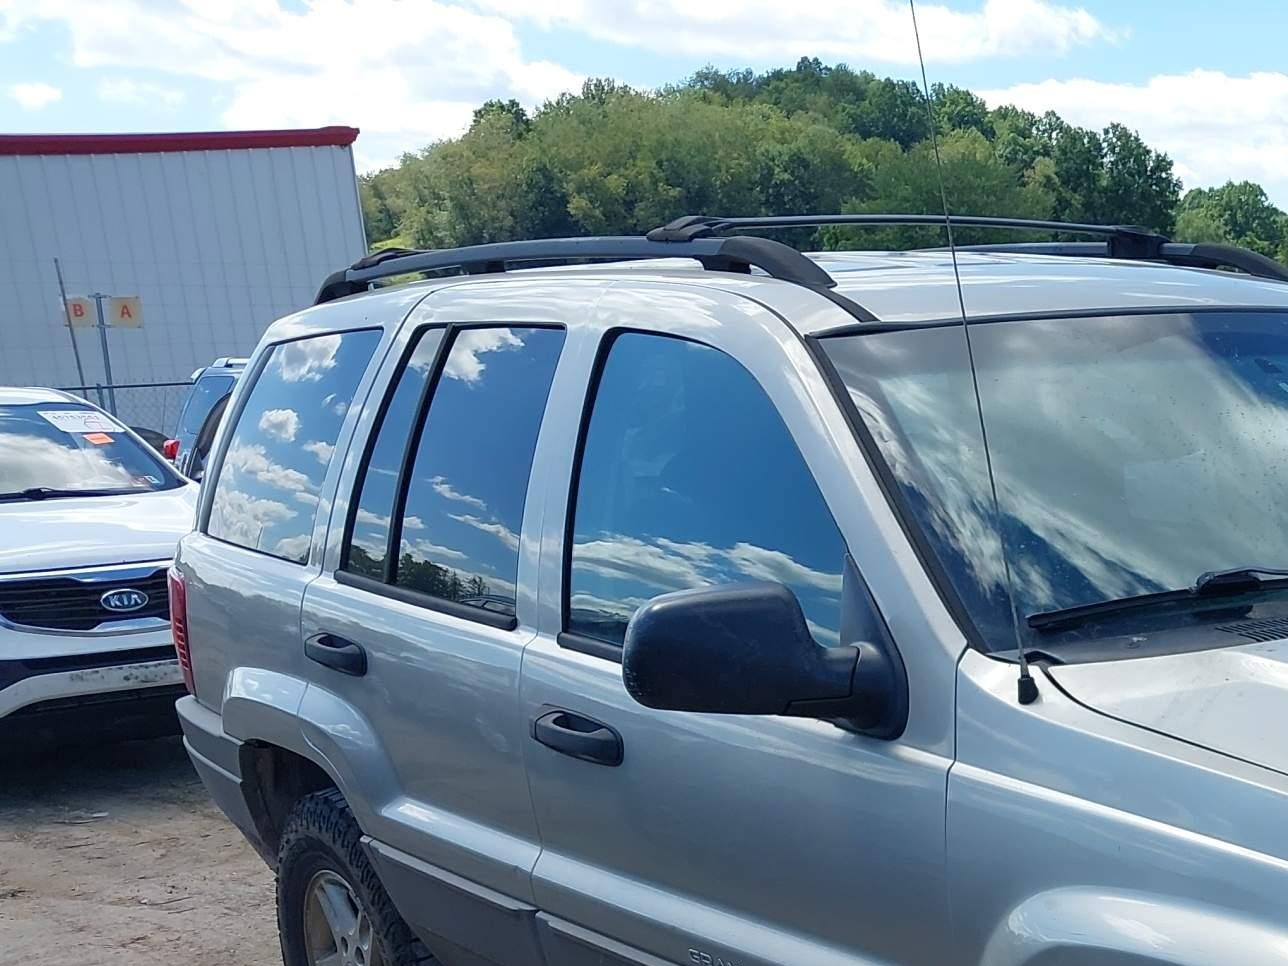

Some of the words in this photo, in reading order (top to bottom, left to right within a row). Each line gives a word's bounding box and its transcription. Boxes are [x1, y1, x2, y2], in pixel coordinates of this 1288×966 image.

[72, 303, 84, 317] B
[120, 304, 132, 318] A
[108, 594, 142, 607] KIA
